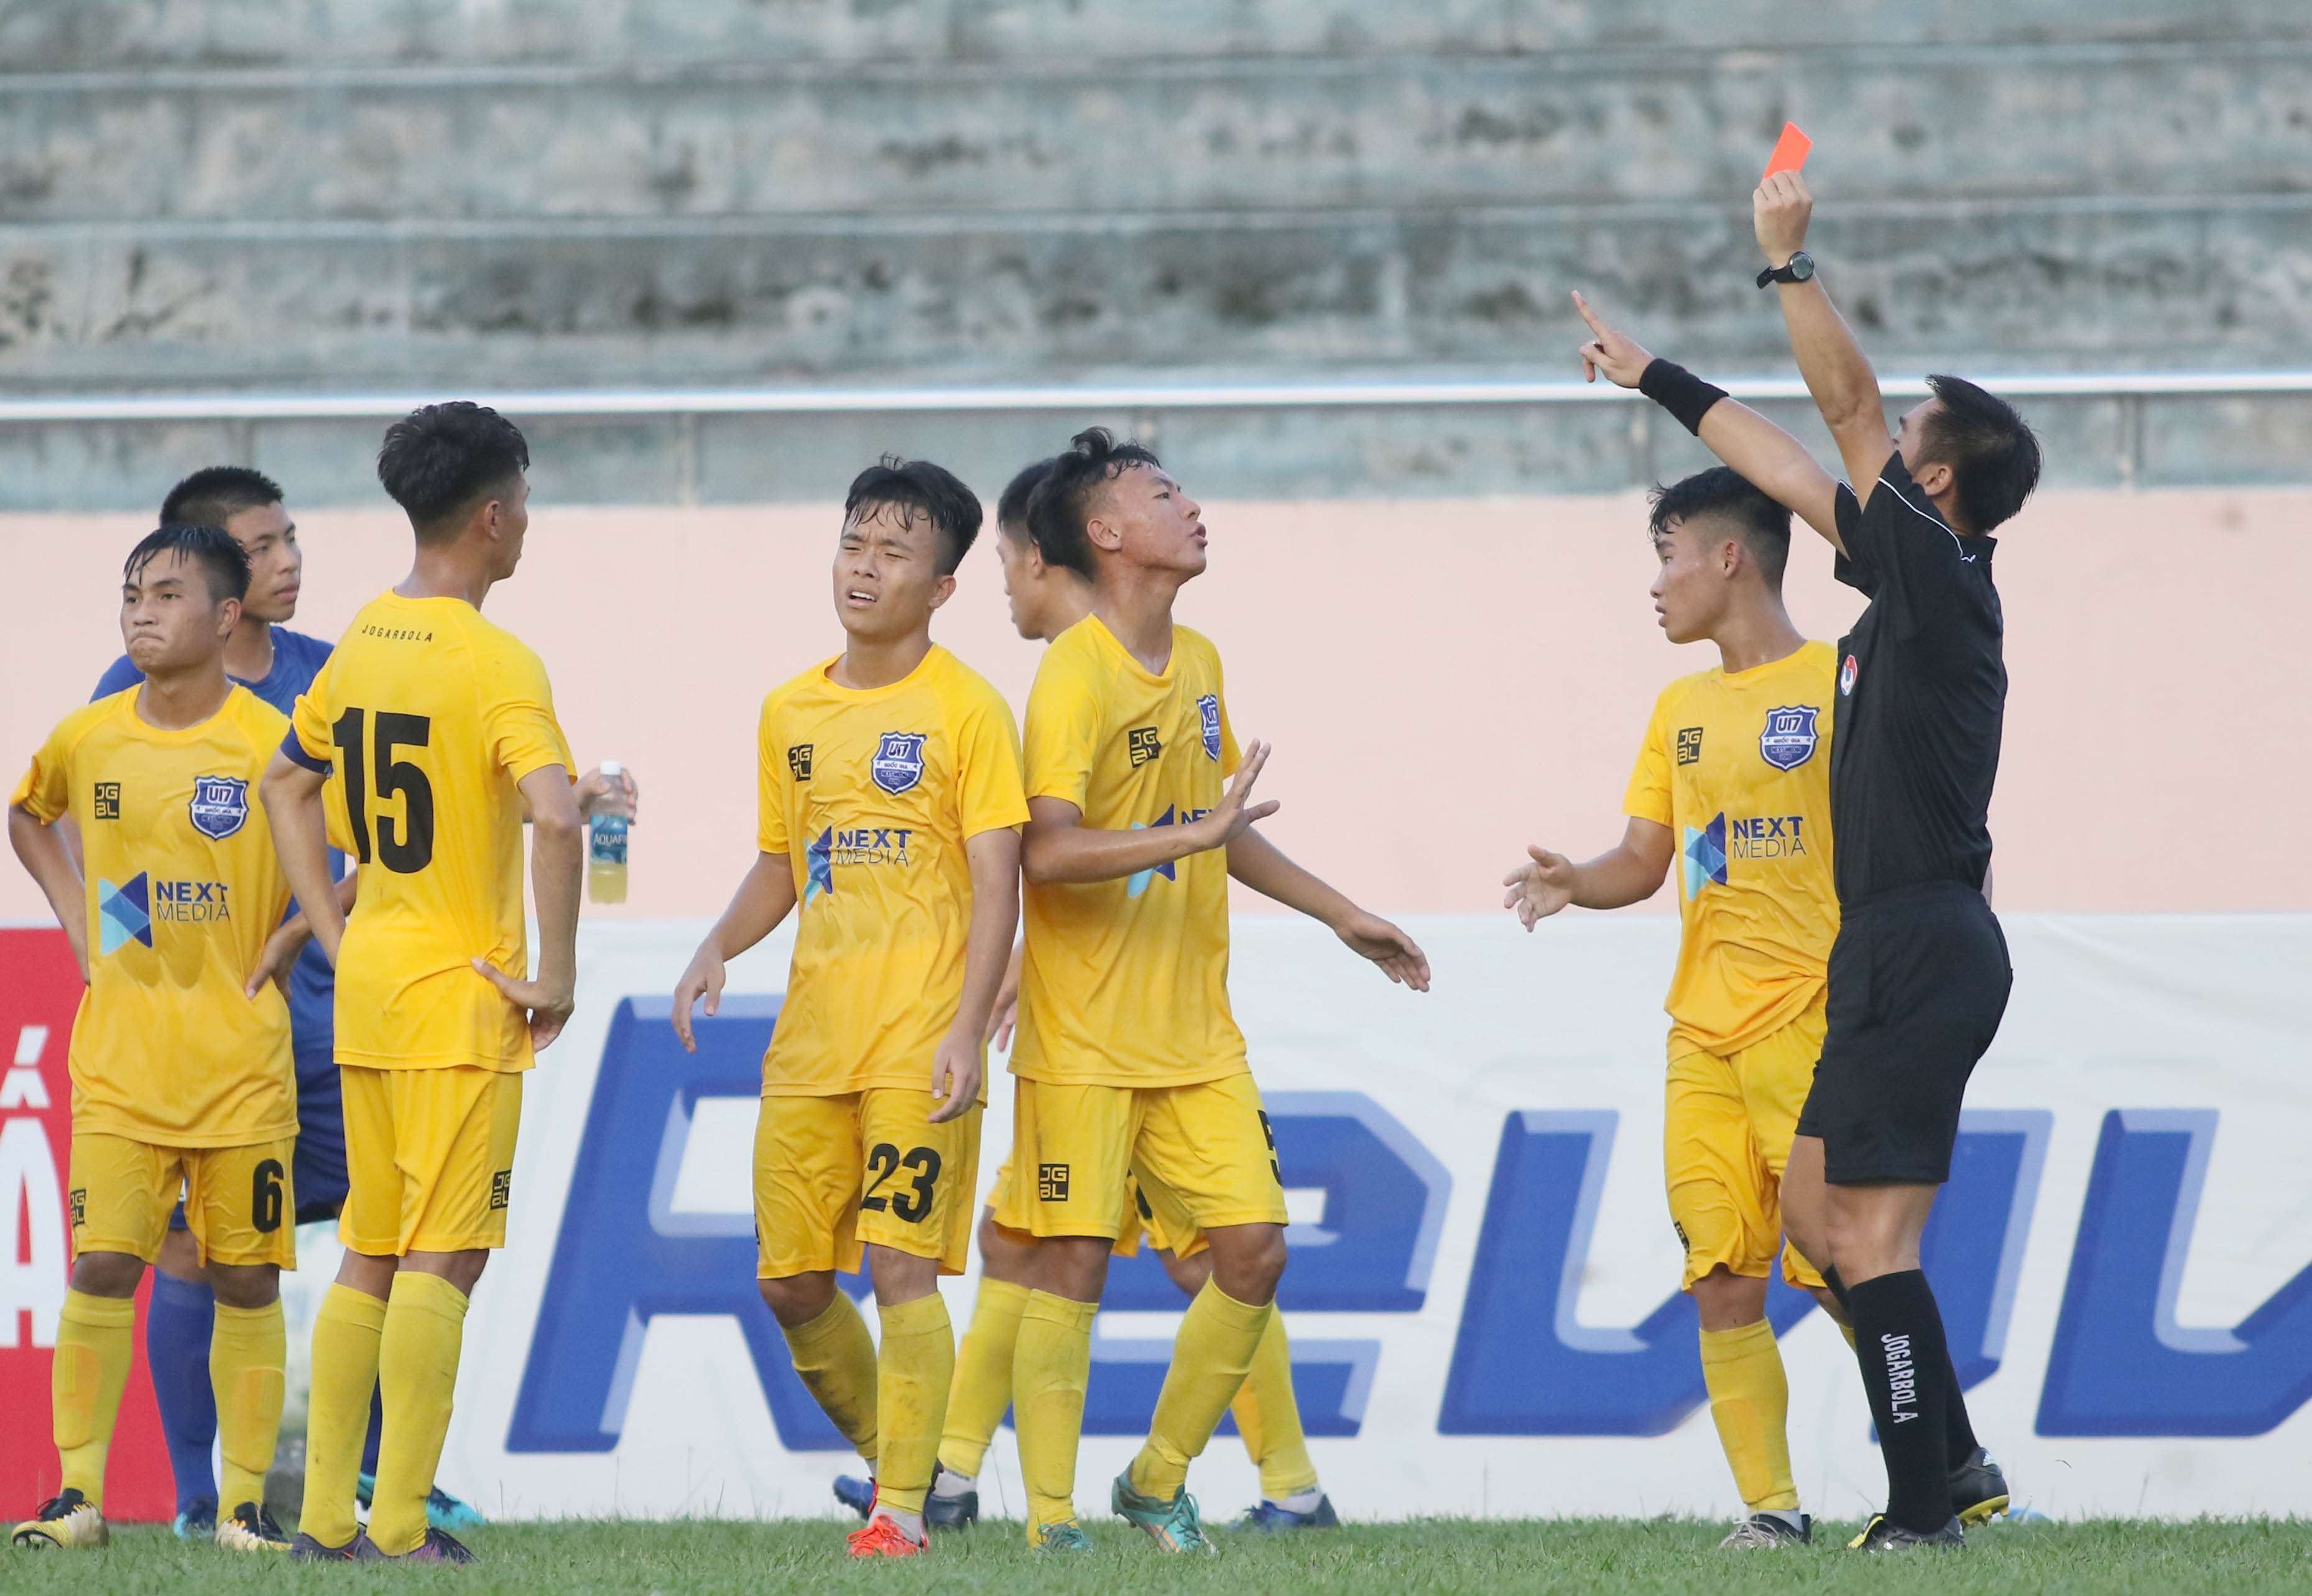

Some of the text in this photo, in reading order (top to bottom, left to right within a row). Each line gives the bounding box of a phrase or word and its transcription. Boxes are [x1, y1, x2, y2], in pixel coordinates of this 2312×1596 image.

[361, 624, 433, 642] JOGARBOLA
[1775, 714, 1803, 733] U17
[207, 786, 233, 803] U17
[332, 706, 434, 874] 15
[1732, 816, 1803, 839] NEXT
[836, 829, 912, 849] NEXT
[1733, 837, 1806, 859] MEDIA
[836, 847, 909, 867] MEDIA
[155, 881, 228, 902] NEXT
[157, 902, 230, 921] MEDIA
[860, 1143, 941, 1224] 23
[252, 1158, 284, 1233] 6
[1880, 1333, 1918, 1424] JOGARBOLA
